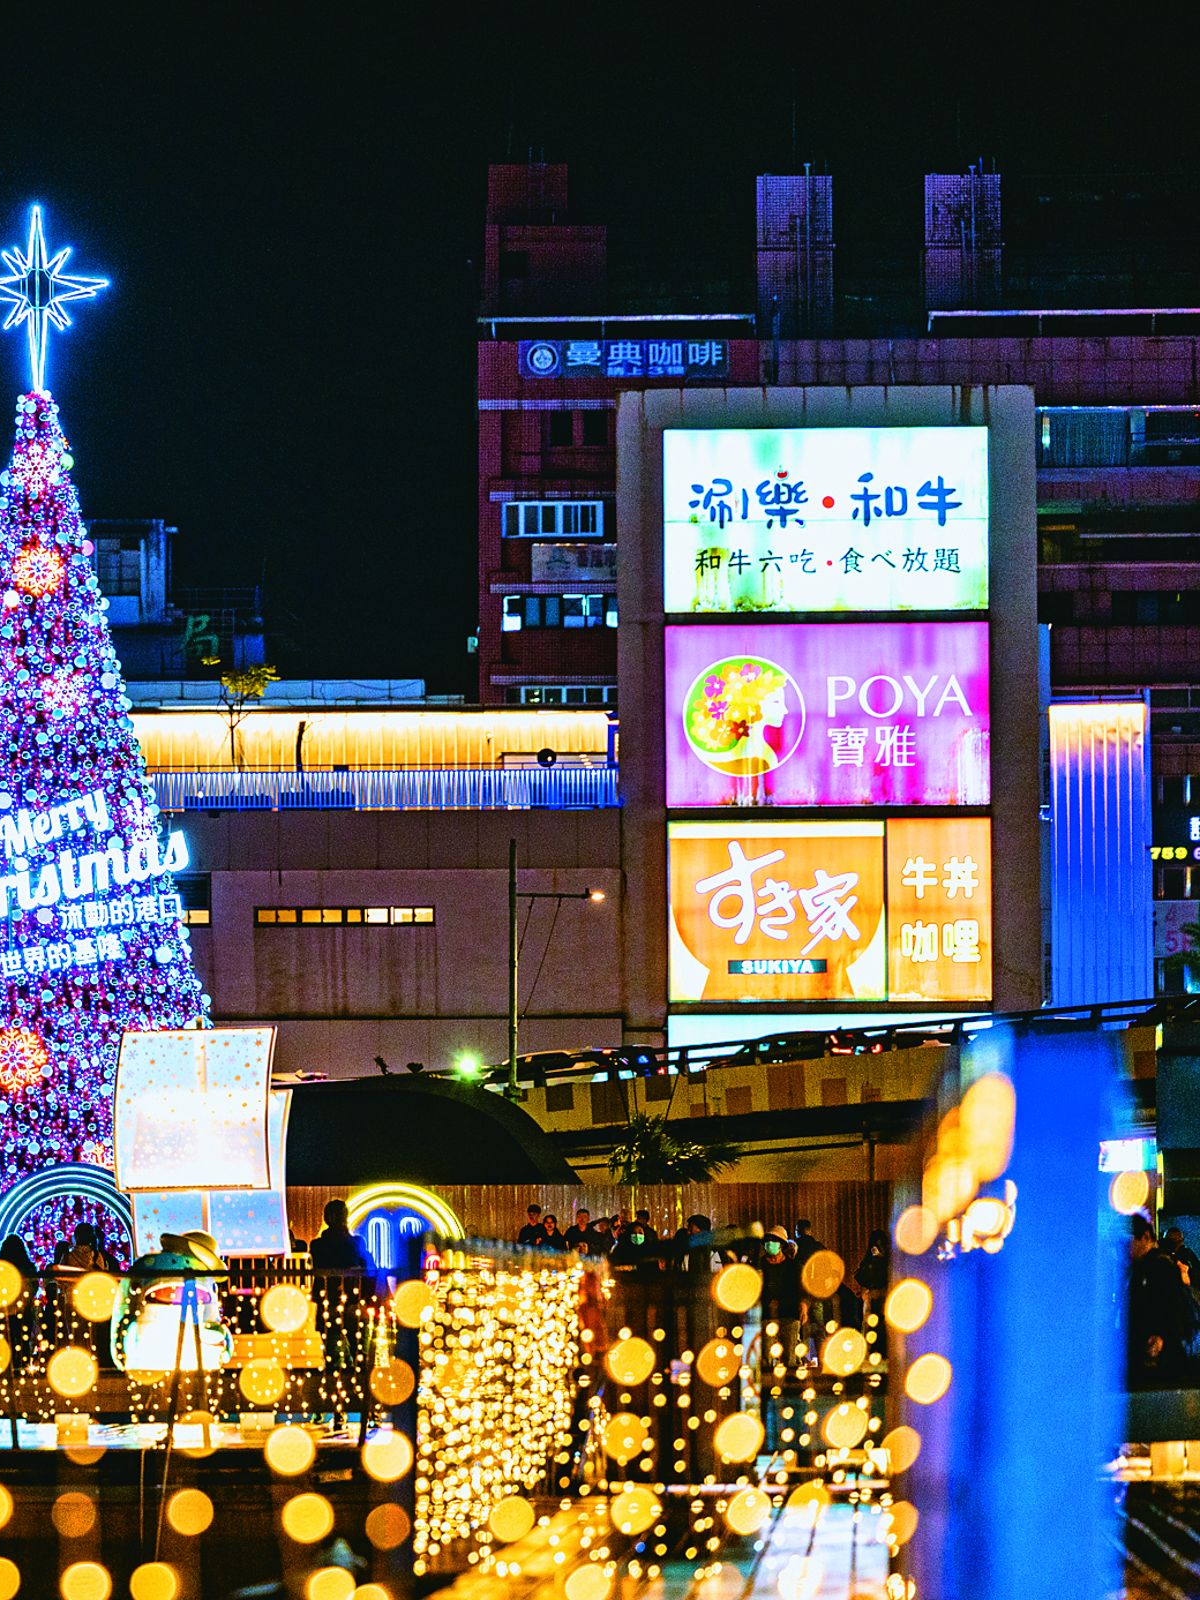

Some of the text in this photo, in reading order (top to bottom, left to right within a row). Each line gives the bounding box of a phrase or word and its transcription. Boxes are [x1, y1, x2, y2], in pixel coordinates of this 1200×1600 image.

[566, 341, 723, 367] 曼典咖啡
[826, 674, 973, 718] POYA
[827, 725, 917, 768] 寶雅
[695, 840, 861, 957] すき家
[901, 855, 979, 899] 牛丼
[58, 892, 183, 930] 流動的港口
[901, 918, 981, 964] 咖哩
[740, 959, 815, 974] SUKIYA
